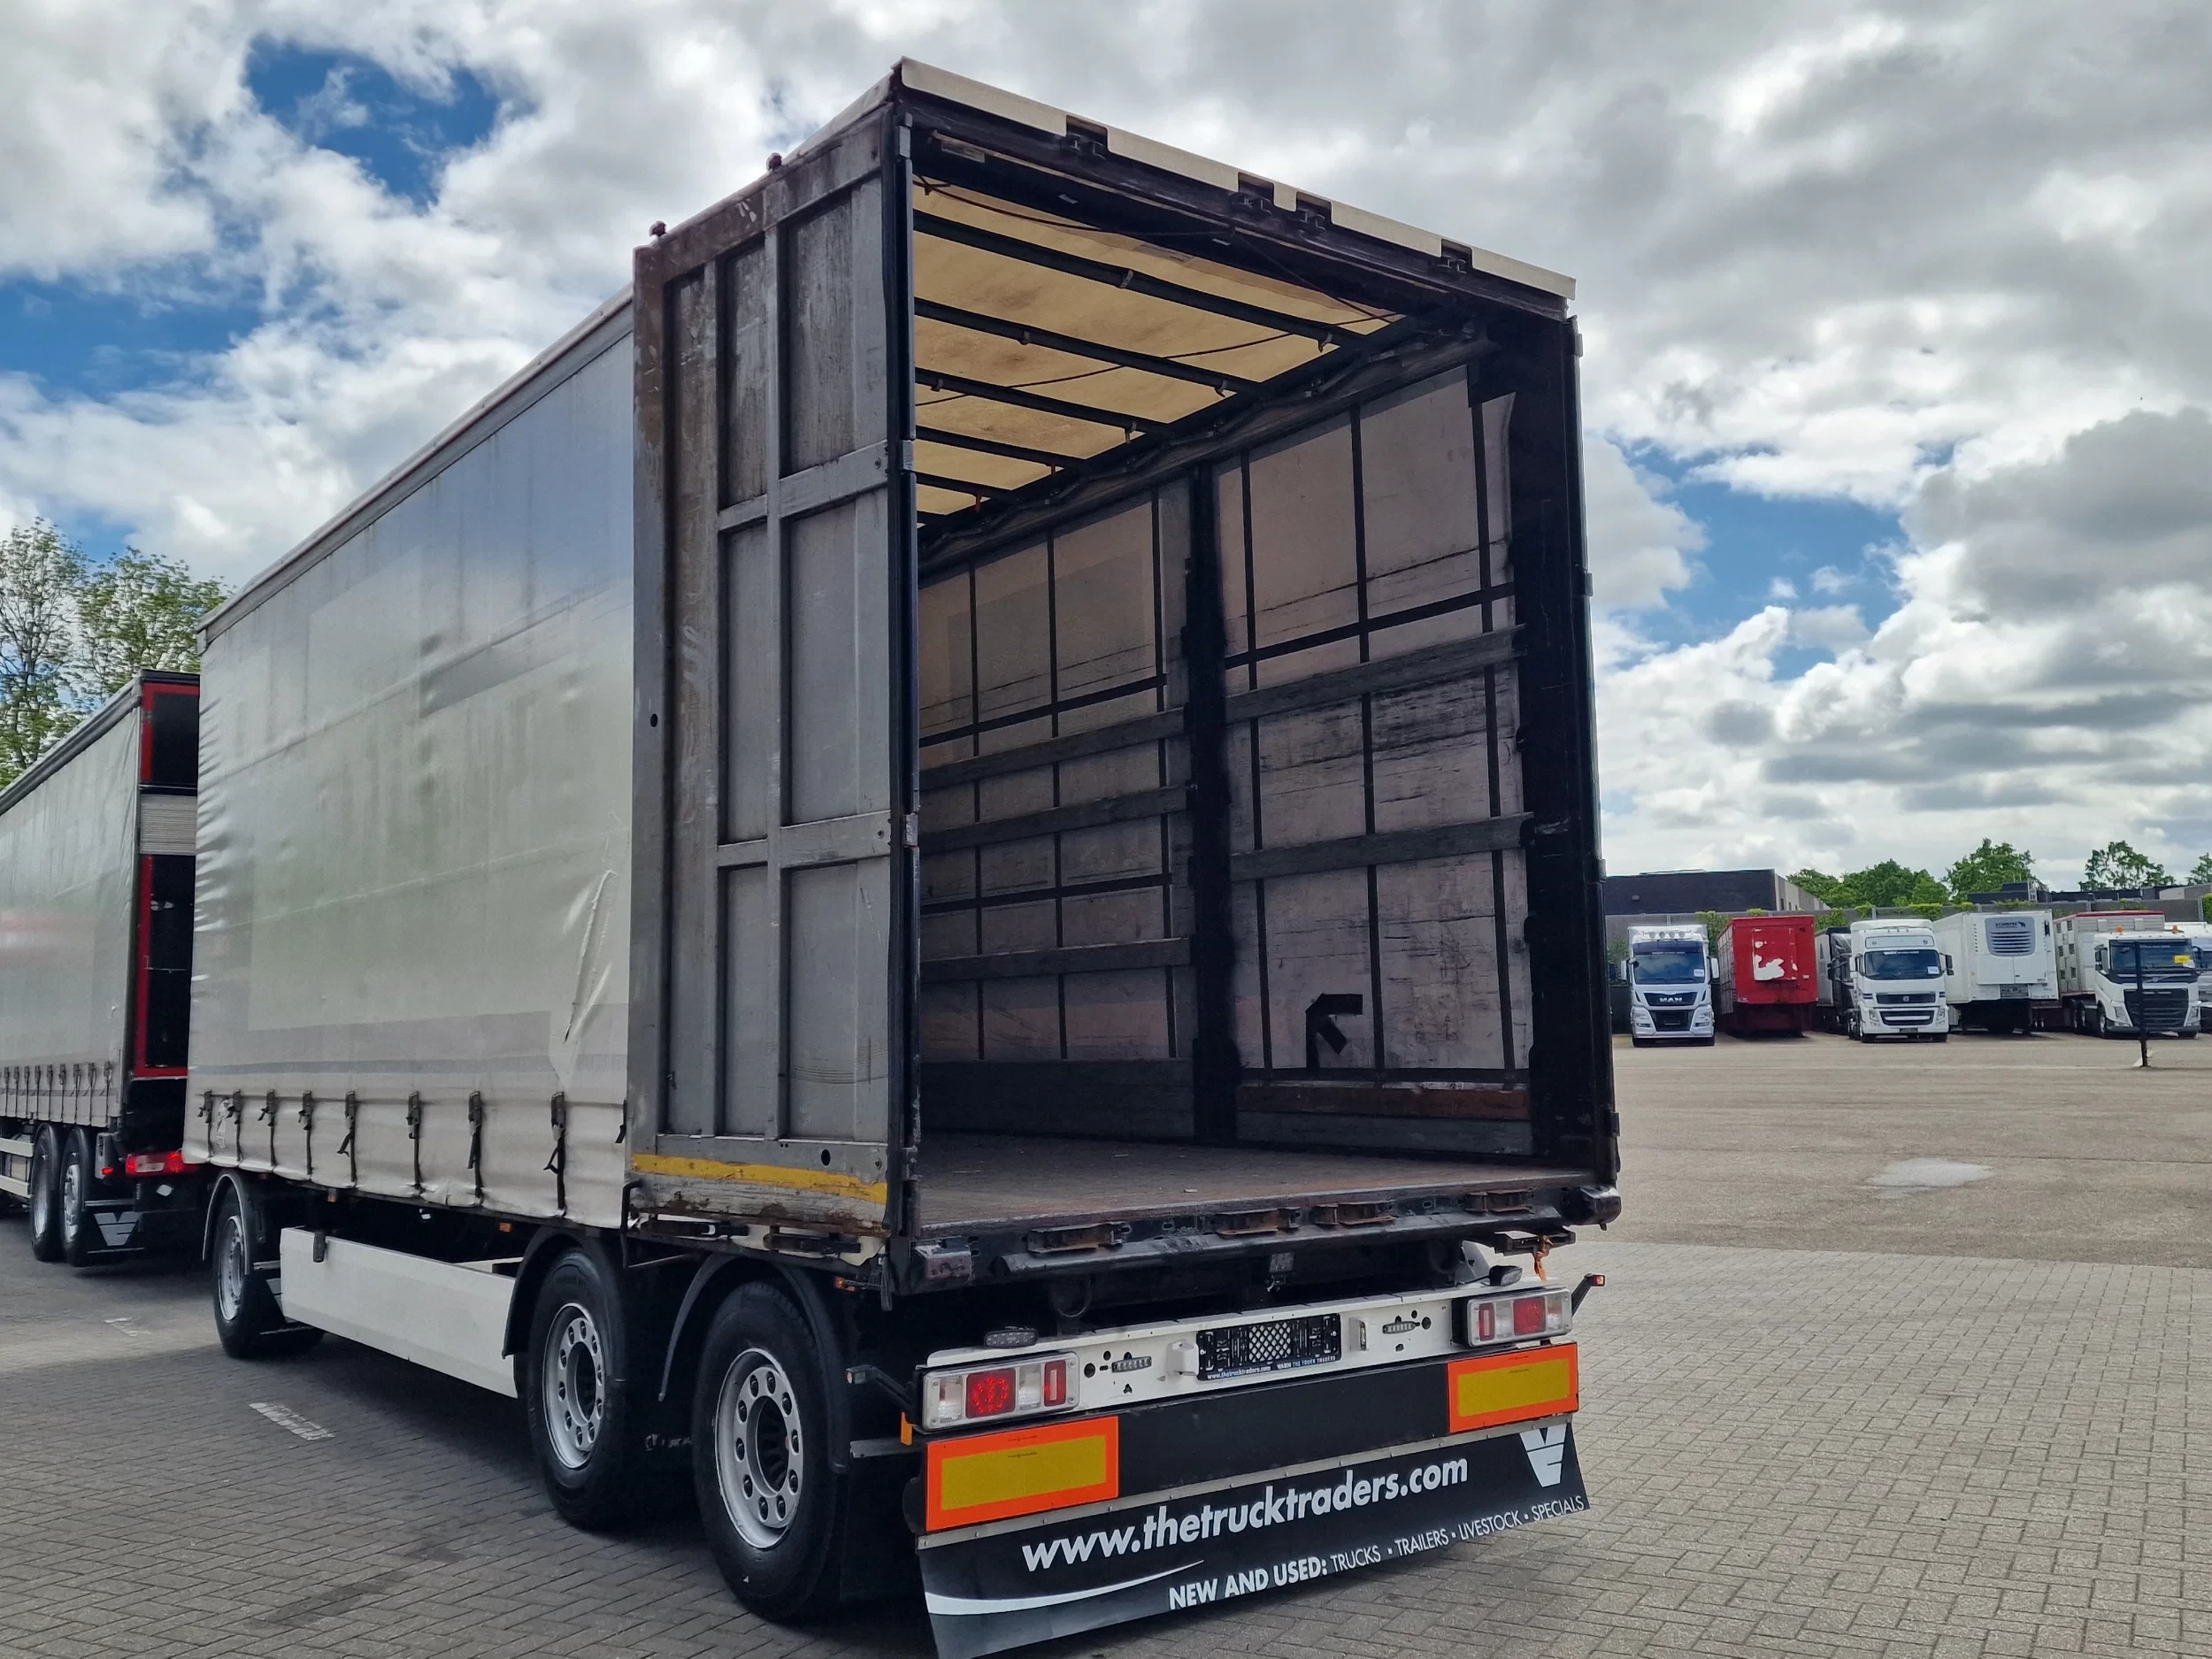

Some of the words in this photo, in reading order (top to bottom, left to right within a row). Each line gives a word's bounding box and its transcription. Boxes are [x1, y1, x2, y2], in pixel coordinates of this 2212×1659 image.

[1021, 1457, 1468, 1572] www.thetrucktraders.com
[1169, 1578, 1217, 1609] NEW
[1225, 1568, 1269, 1598] AND
[1273, 1556, 1327, 1586] USED:
[1330, 1545, 1381, 1572] TRUCKS
[1394, 1528, 1449, 1556] TRAILERS
[1458, 1509, 1523, 1540] LIVESTOCK
[1531, 1495, 1585, 1521] SPECIALS
